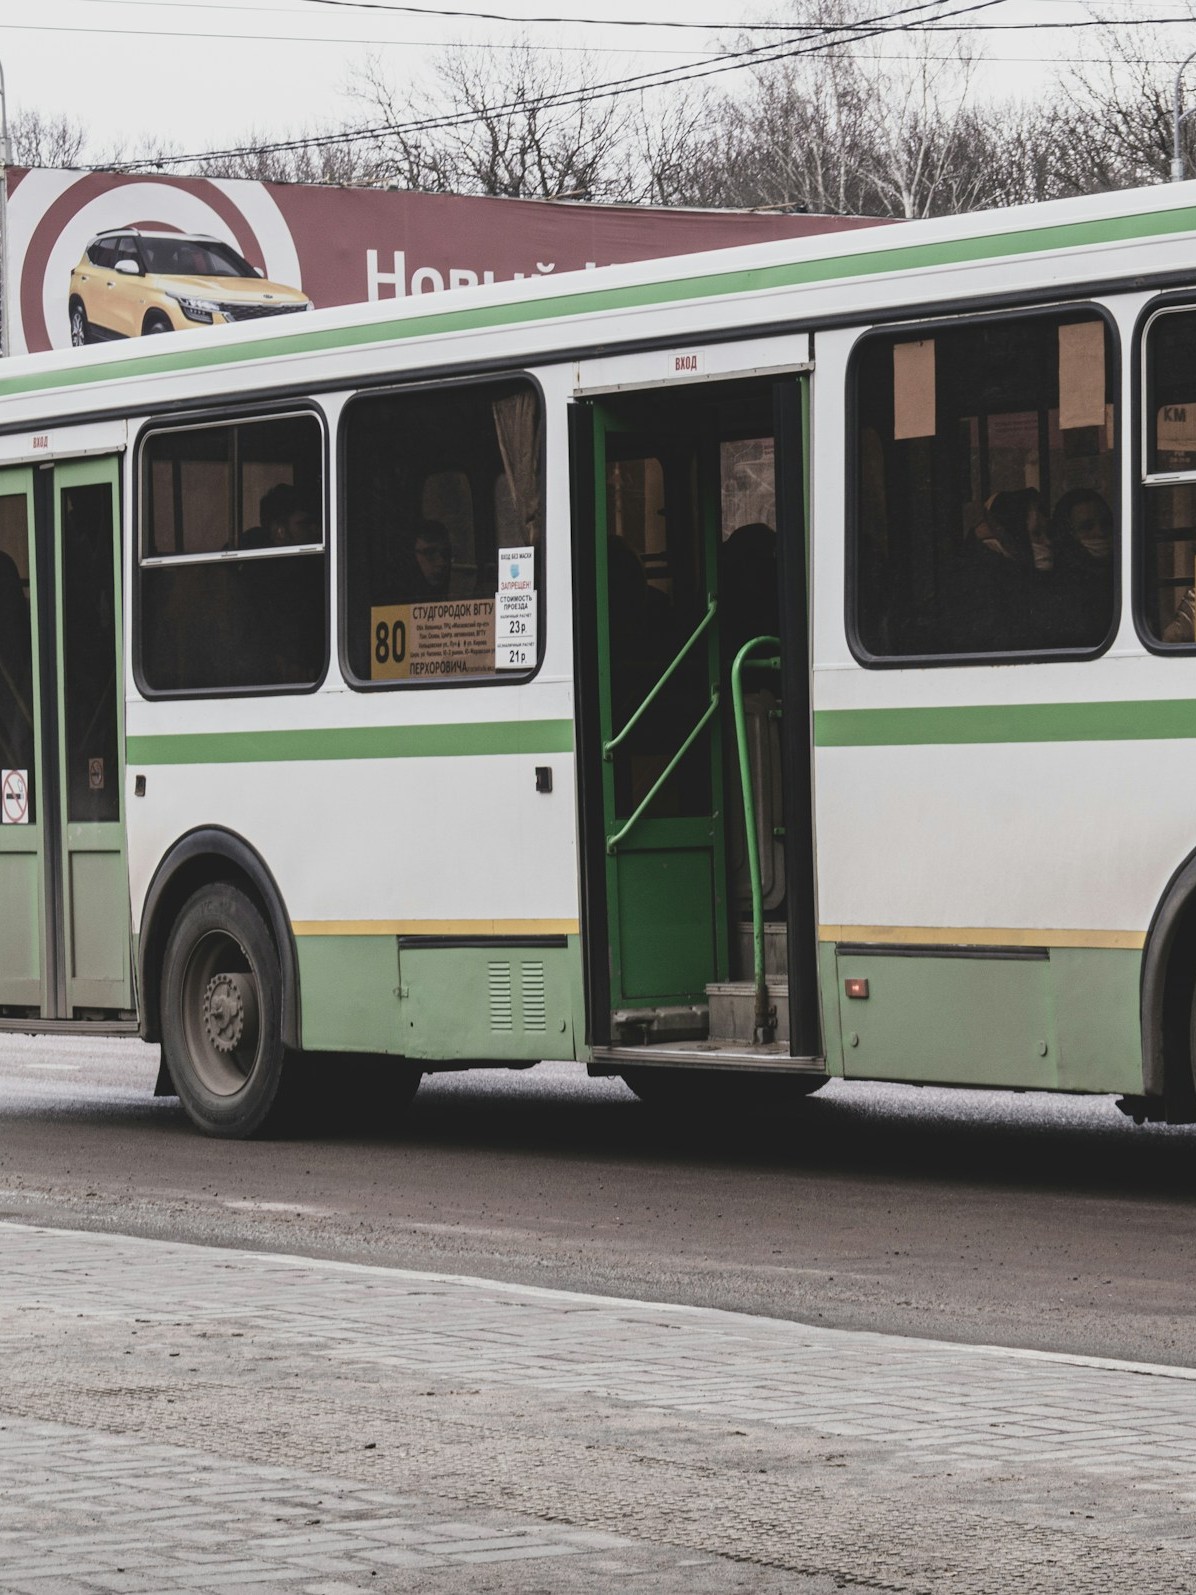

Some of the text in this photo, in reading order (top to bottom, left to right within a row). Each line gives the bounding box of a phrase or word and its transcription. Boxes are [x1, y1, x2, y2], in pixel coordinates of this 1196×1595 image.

[675, 355, 697, 371] ВХОД
[501, 580, 532, 591] ЗАПРЕЩЕН!
[500, 595, 532, 603] СТОИМОСТЬ
[504, 602, 528, 610] ПРОЕЗДА
[413, 602, 494, 620] СТУДГОРОДОК ВГТУ
[376, 620, 406, 663] 80
[409, 660, 467, 675] ПЕРХОРОВИЧА
